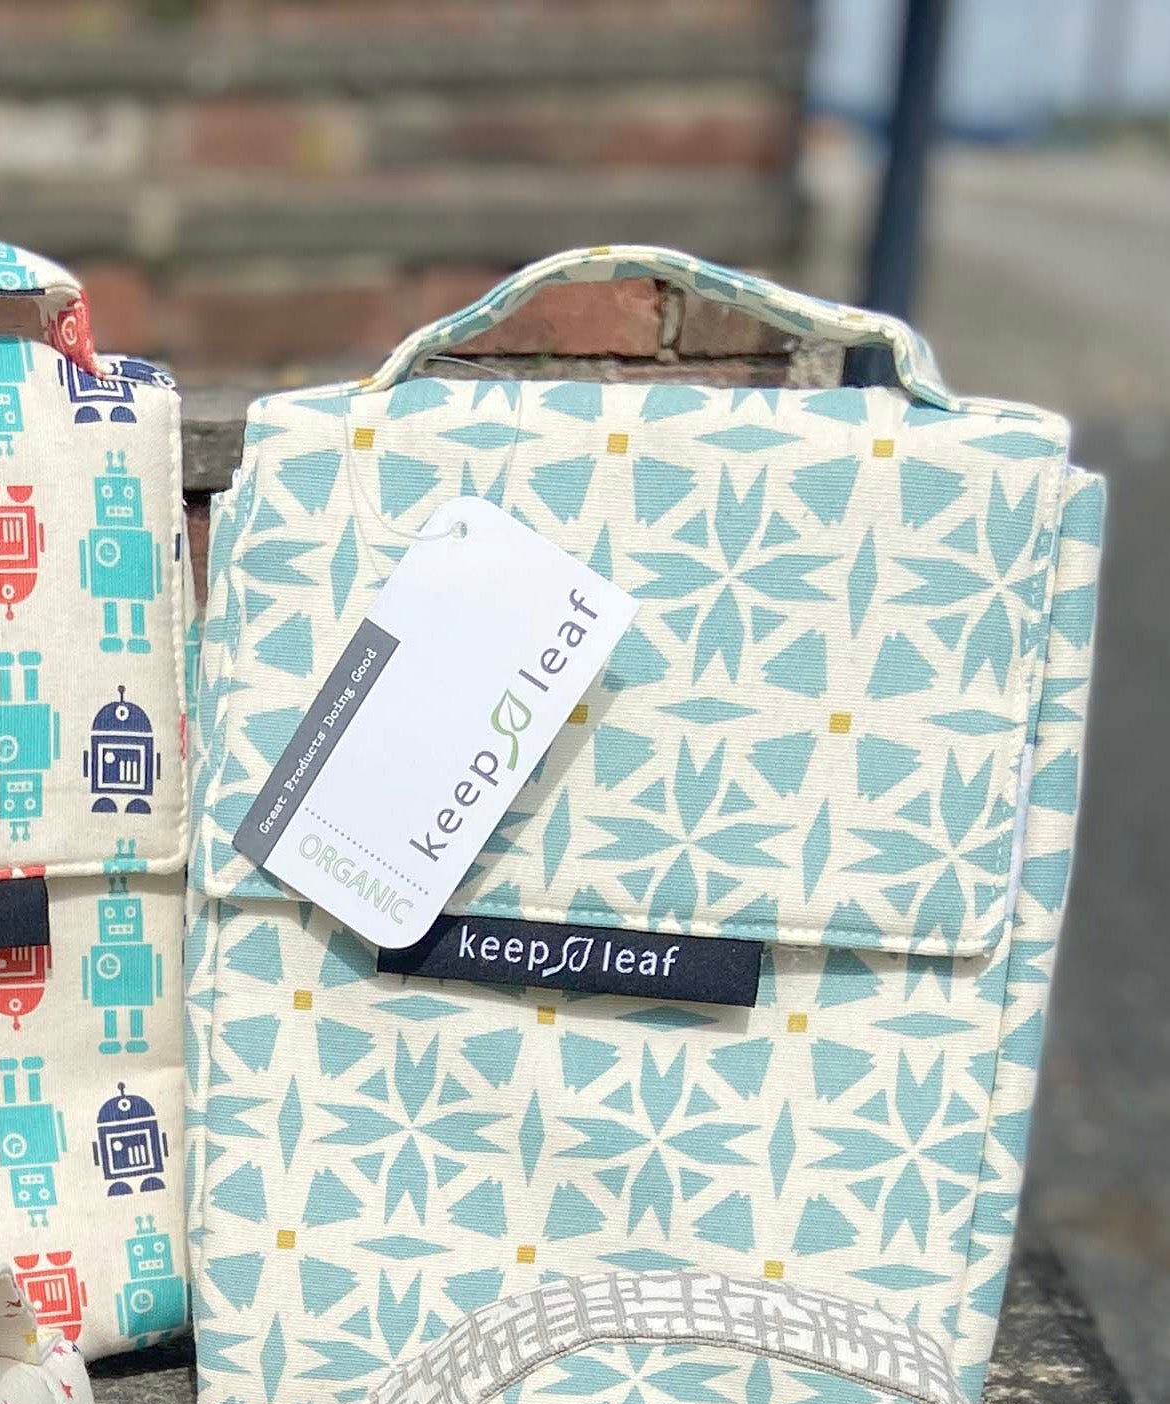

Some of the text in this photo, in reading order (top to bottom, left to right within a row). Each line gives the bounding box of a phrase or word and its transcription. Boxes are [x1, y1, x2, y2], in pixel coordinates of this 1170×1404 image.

[258, 647, 378, 835] Great Products Doing Good
[409, 588, 599, 862] keep leaf
[298, 832, 415, 926] ORGANIC
[458, 925, 681, 978] keep leaf
